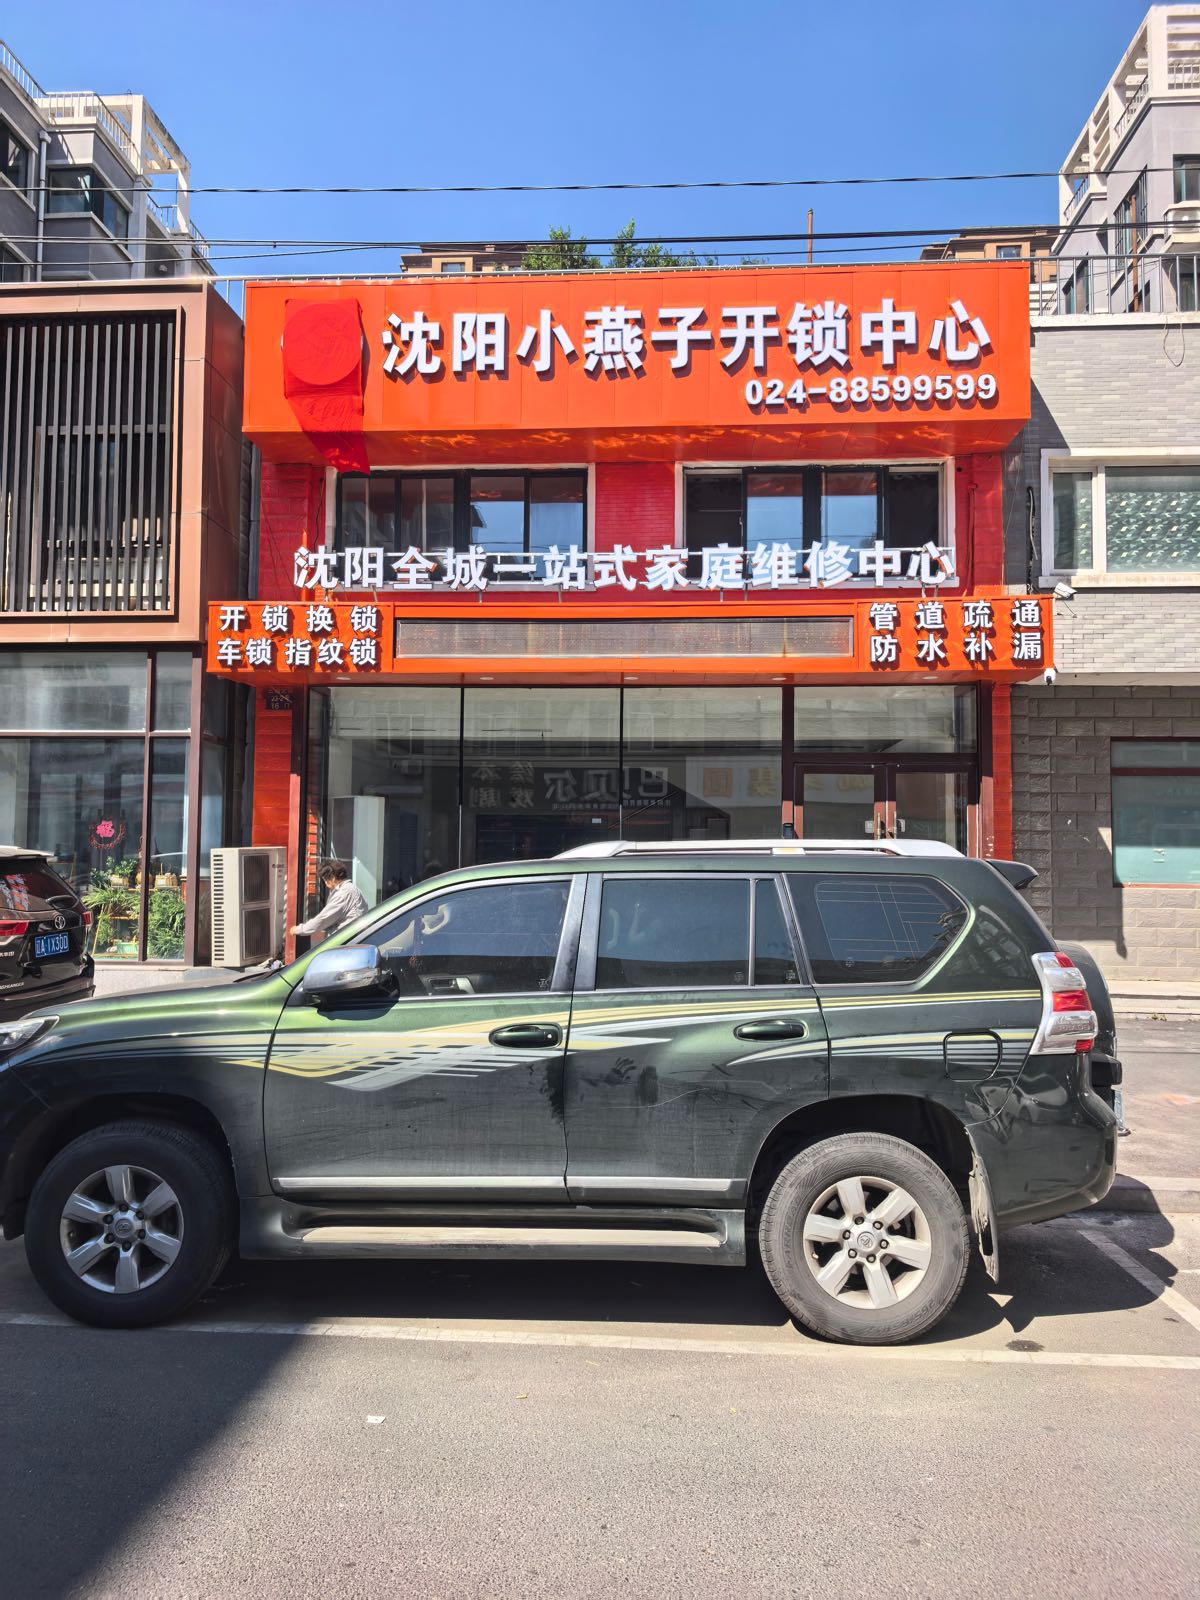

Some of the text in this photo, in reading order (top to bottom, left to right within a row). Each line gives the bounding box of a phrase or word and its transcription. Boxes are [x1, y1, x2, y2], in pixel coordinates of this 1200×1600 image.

[382, 298, 991, 374] 沈阳小燕子开锁中心
[745, 374, 997, 406] 024-88599599
[293, 540, 955, 591] 沈阳全城一站式家庭维修中心
[219, 605, 379, 633] 开锁换锁
[869, 600, 1041, 631] 管道疏通
[869, 632, 1041, 662] 防水补漏
